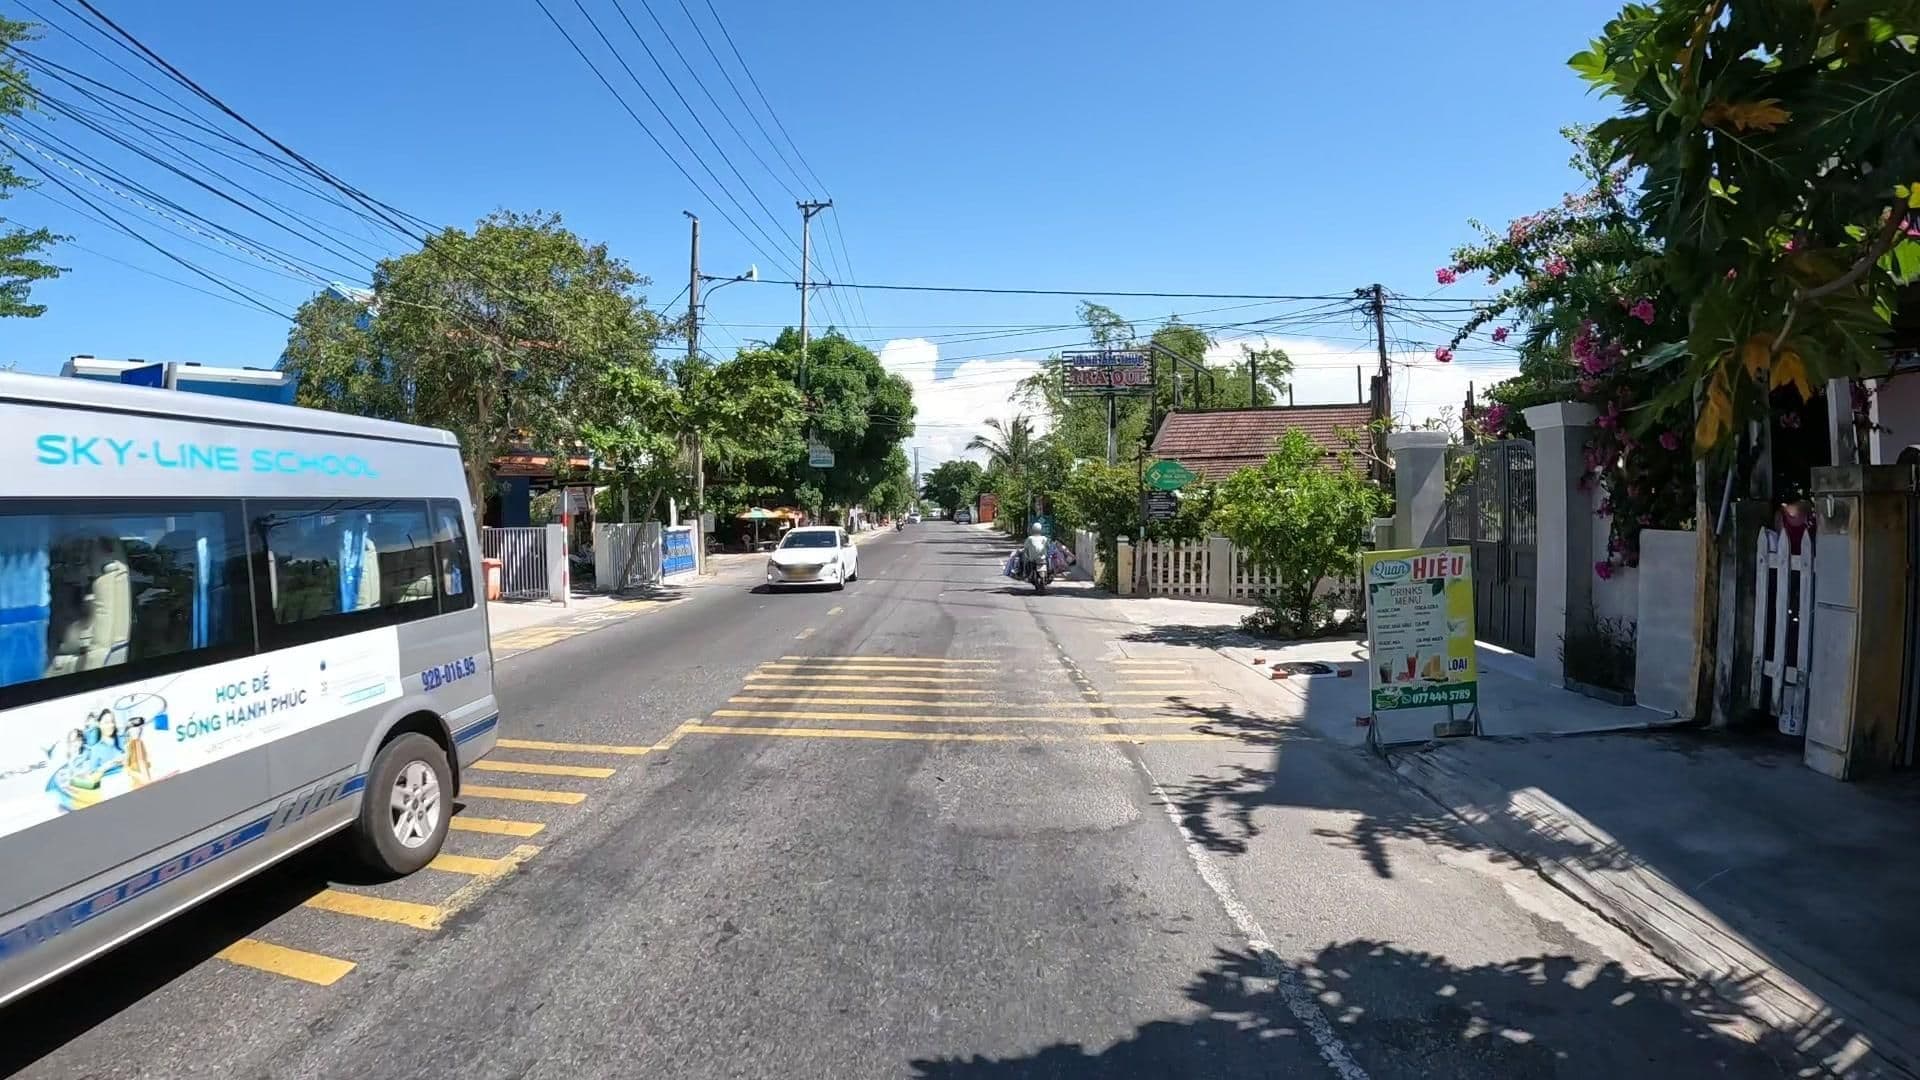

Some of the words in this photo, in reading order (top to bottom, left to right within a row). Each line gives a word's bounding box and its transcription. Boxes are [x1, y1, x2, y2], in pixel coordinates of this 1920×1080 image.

[36, 434, 240, 472] SKY-LINE
[251, 447, 381, 480] SCHOOL
[1390, 586, 1423, 597] DRINKS
[1394, 595, 1422, 606] MENU
[422, 656, 476, 691] 92B-016.95
[1448, 657, 1468, 673] LOẠI
[215, 680, 248, 704] HỌC
[1412, 692, 1428, 704] 077
[1430, 691, 1448, 702] 444
[1449, 689, 1471, 701] 5789
[176, 711, 222, 742] SỐNG
[226, 701, 268, 728] HẠNH
[271, 688, 308, 714] PHÚC
